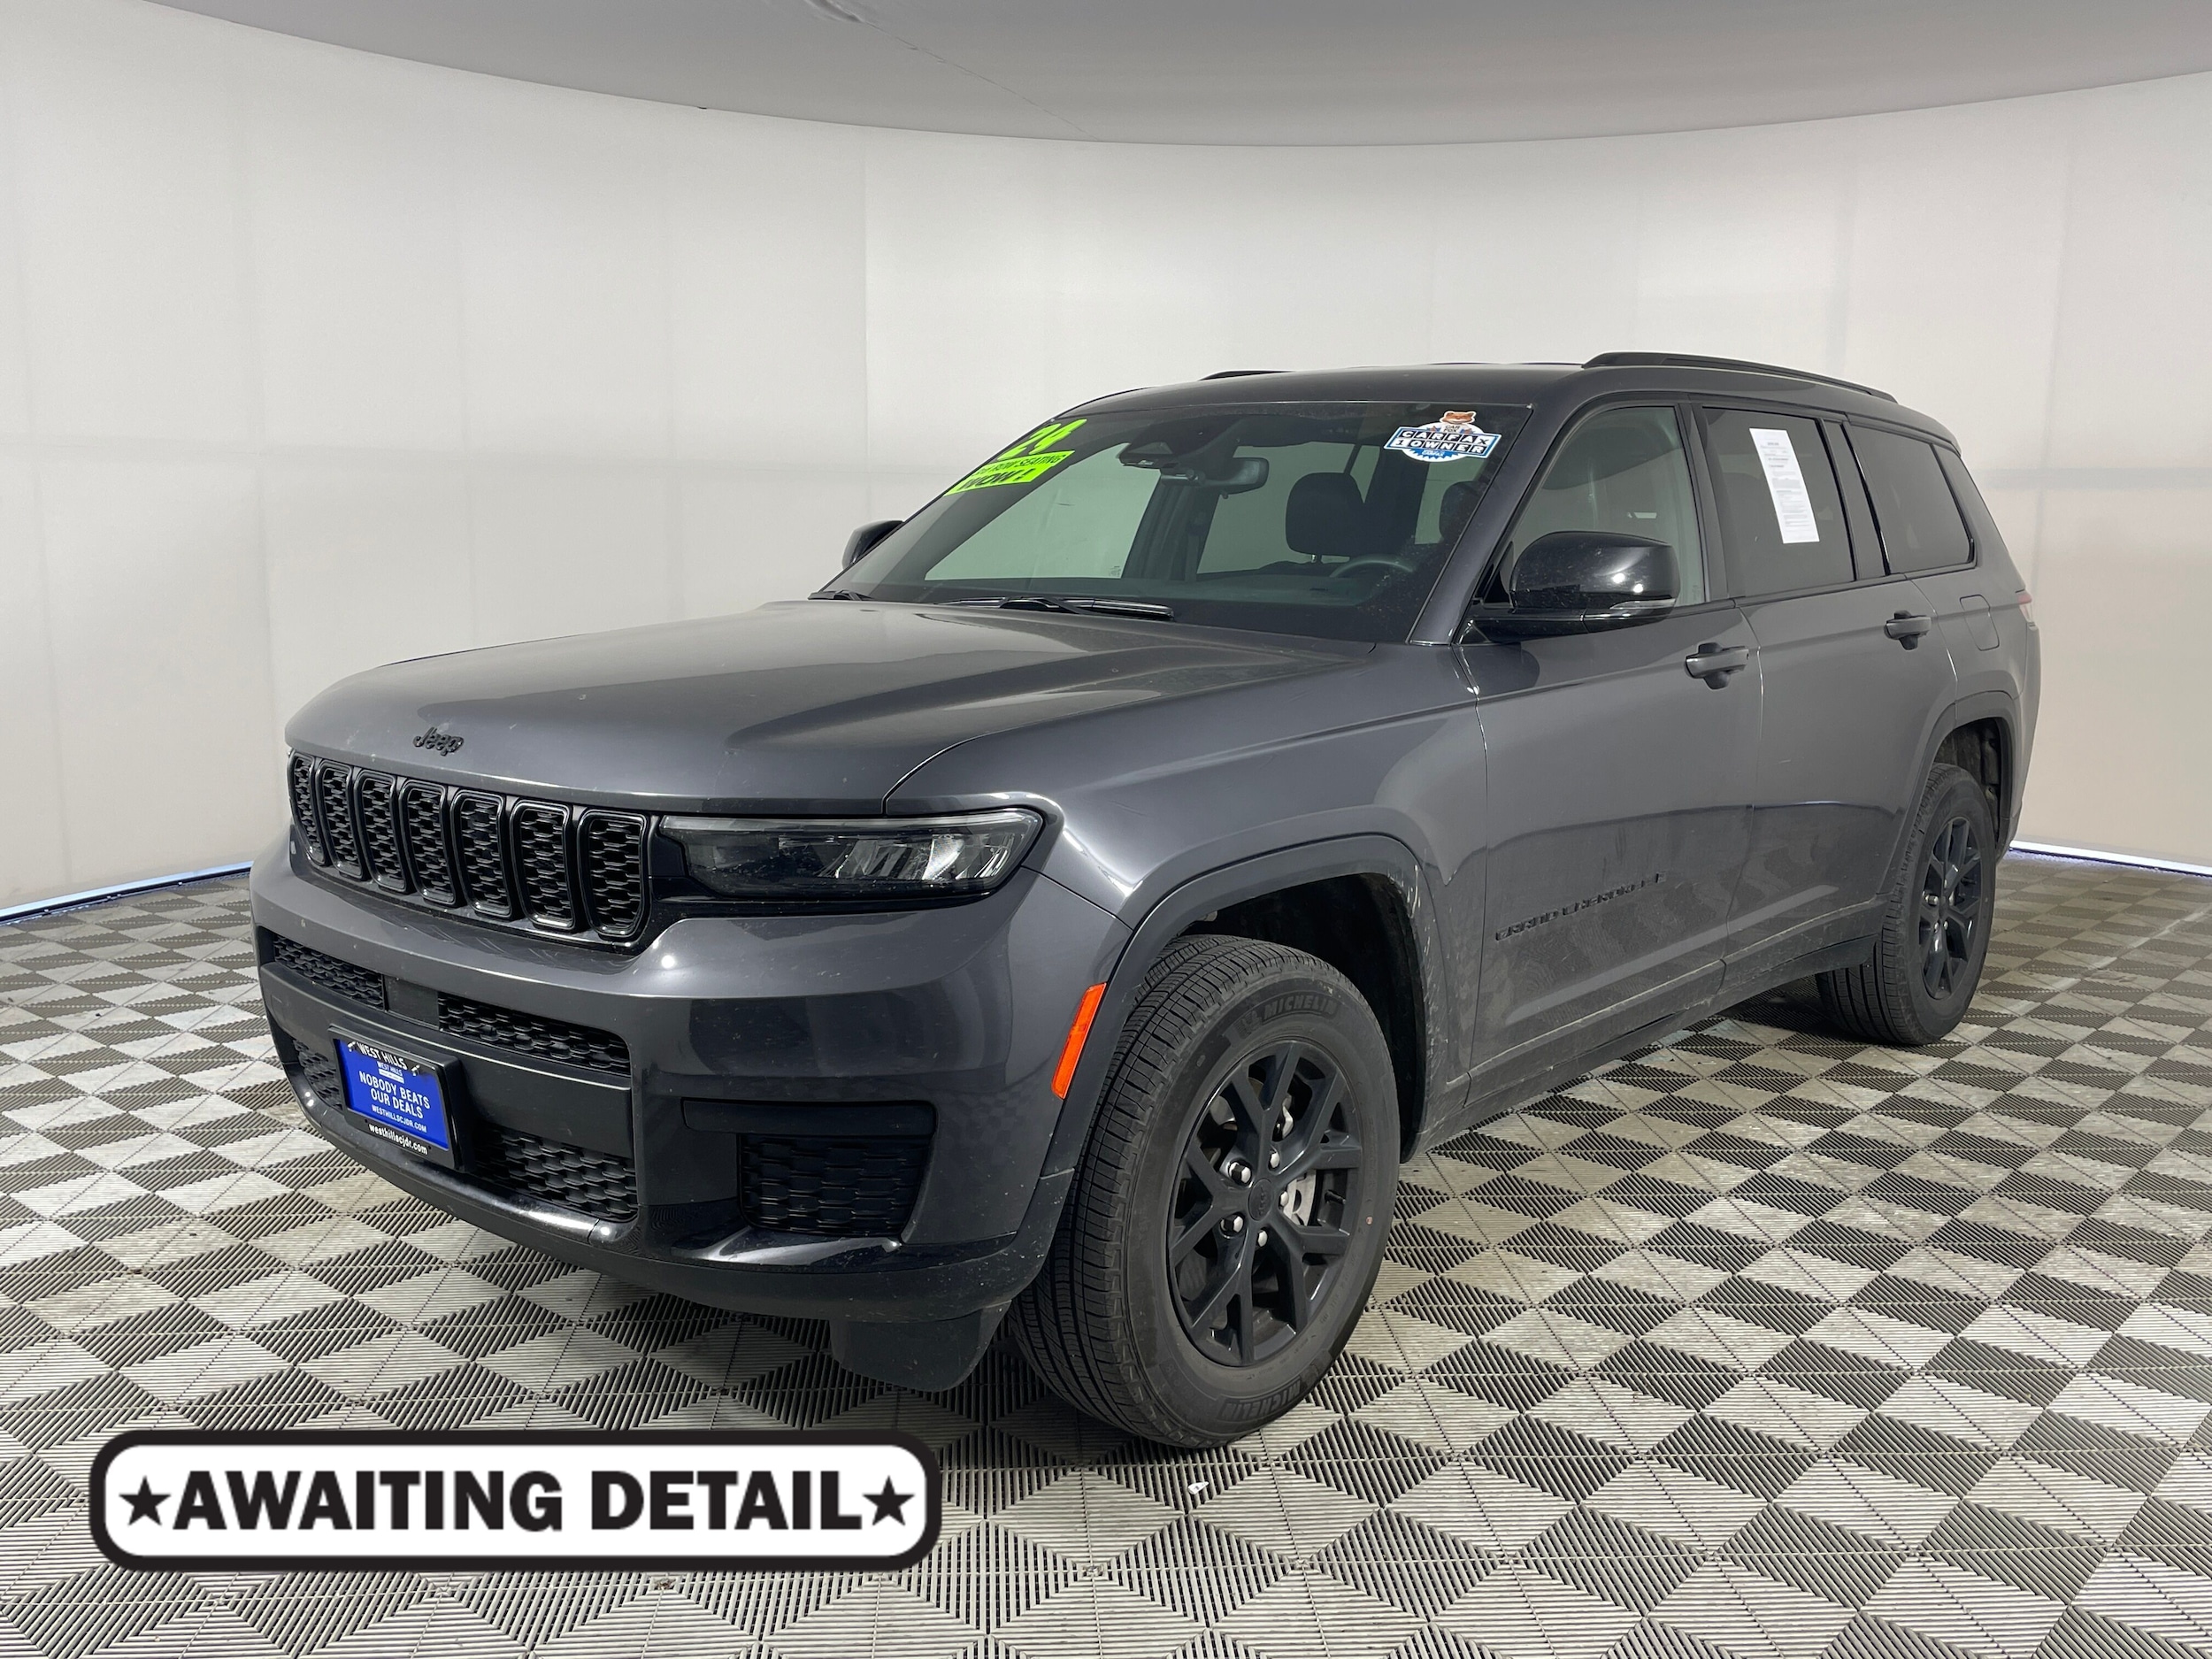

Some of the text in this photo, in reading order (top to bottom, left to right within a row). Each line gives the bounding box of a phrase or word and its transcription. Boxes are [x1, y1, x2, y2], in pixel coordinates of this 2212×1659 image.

[997, 419, 1087, 460] 24
[1402, 430, 1489, 446] CARFAX
[413, 726, 464, 757] Jeep
[1263, 994, 1339, 1018] MICHELIN
[357, 1041, 407, 1071] WEST HILLS
[358, 1071, 396, 1095] NOBODY
[400, 1087, 430, 1110] BEATS
[370, 1088, 423, 1118] OUR DEALS
[372, 1104, 426, 1133] WESTHILLSCJDR.COM
[369, 1123, 428, 1155] westhillscjdr.com
[1220, 1379, 1302, 1421] MICHELIN
